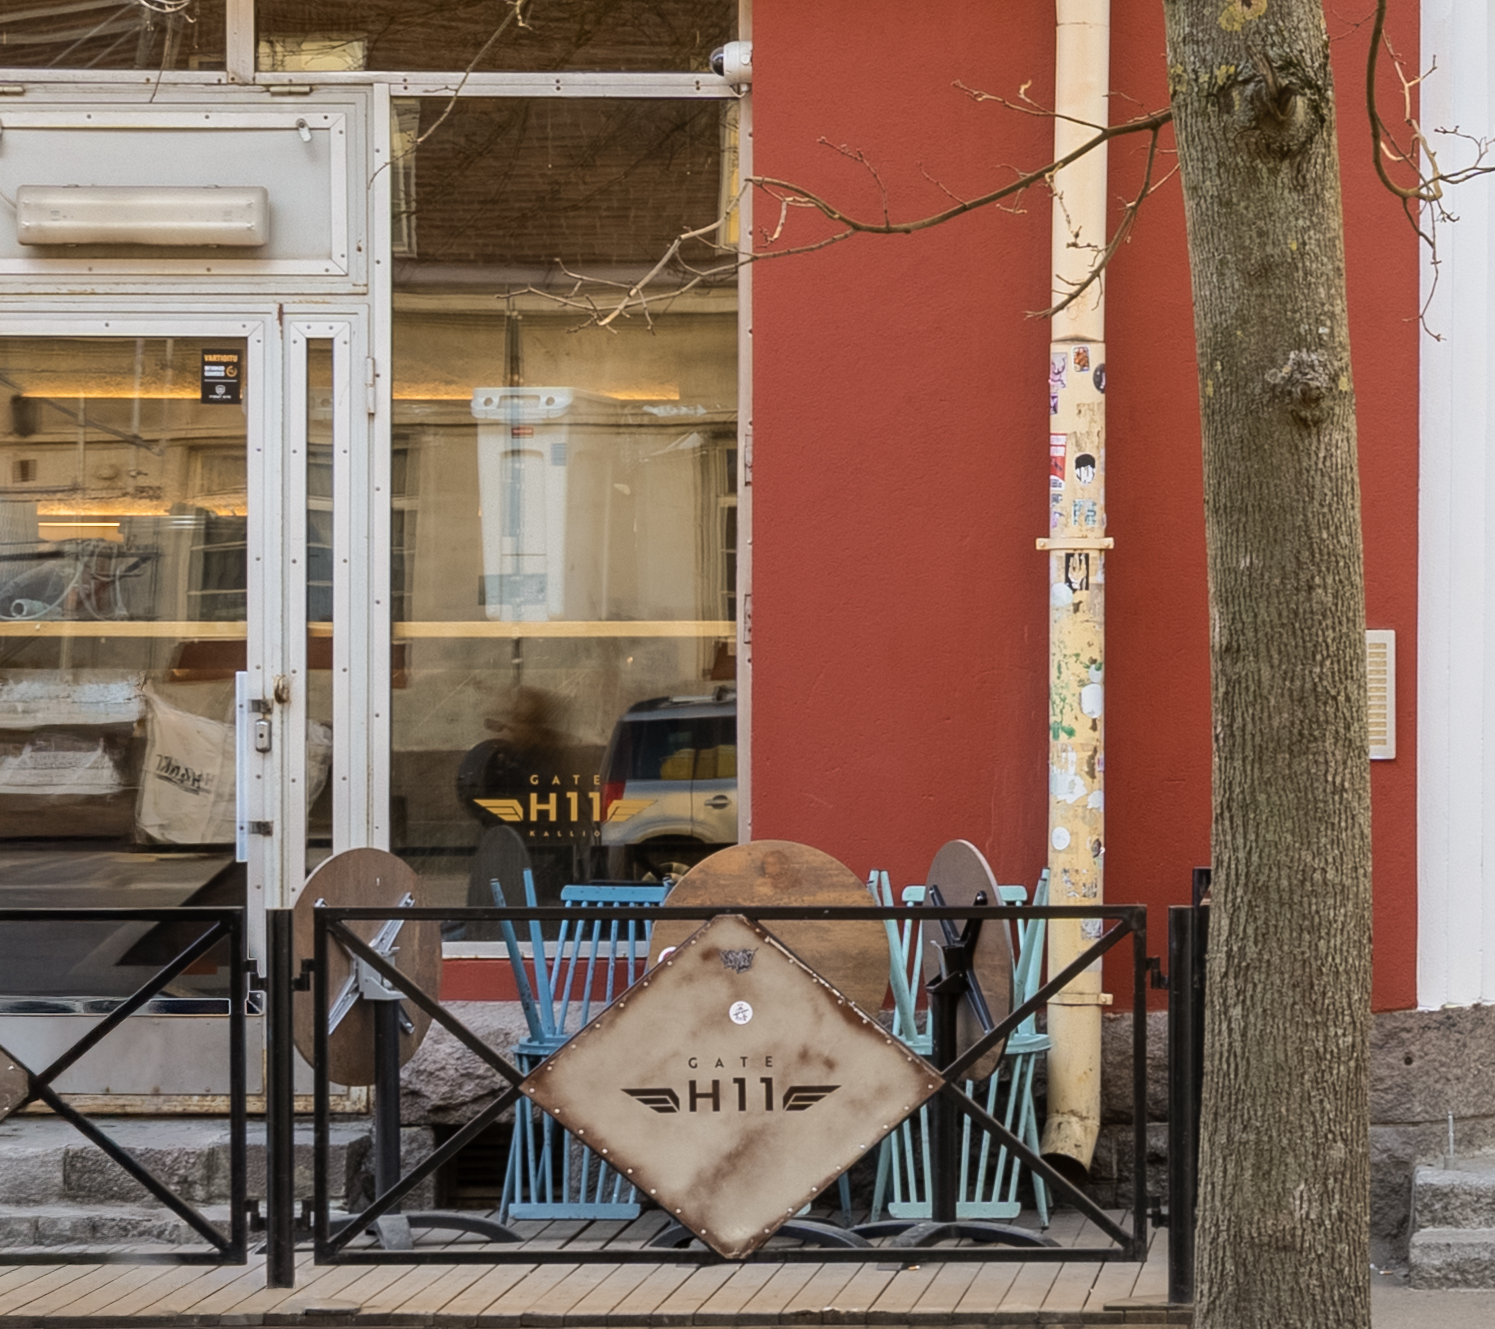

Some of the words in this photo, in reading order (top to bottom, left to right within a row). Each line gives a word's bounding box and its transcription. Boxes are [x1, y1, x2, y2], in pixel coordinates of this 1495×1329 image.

[530, 774, 600, 785] GATE
[530, 792, 600, 821] H11
[688, 1056, 774, 1068] GATE
[689, 1077, 774, 1112] H11
